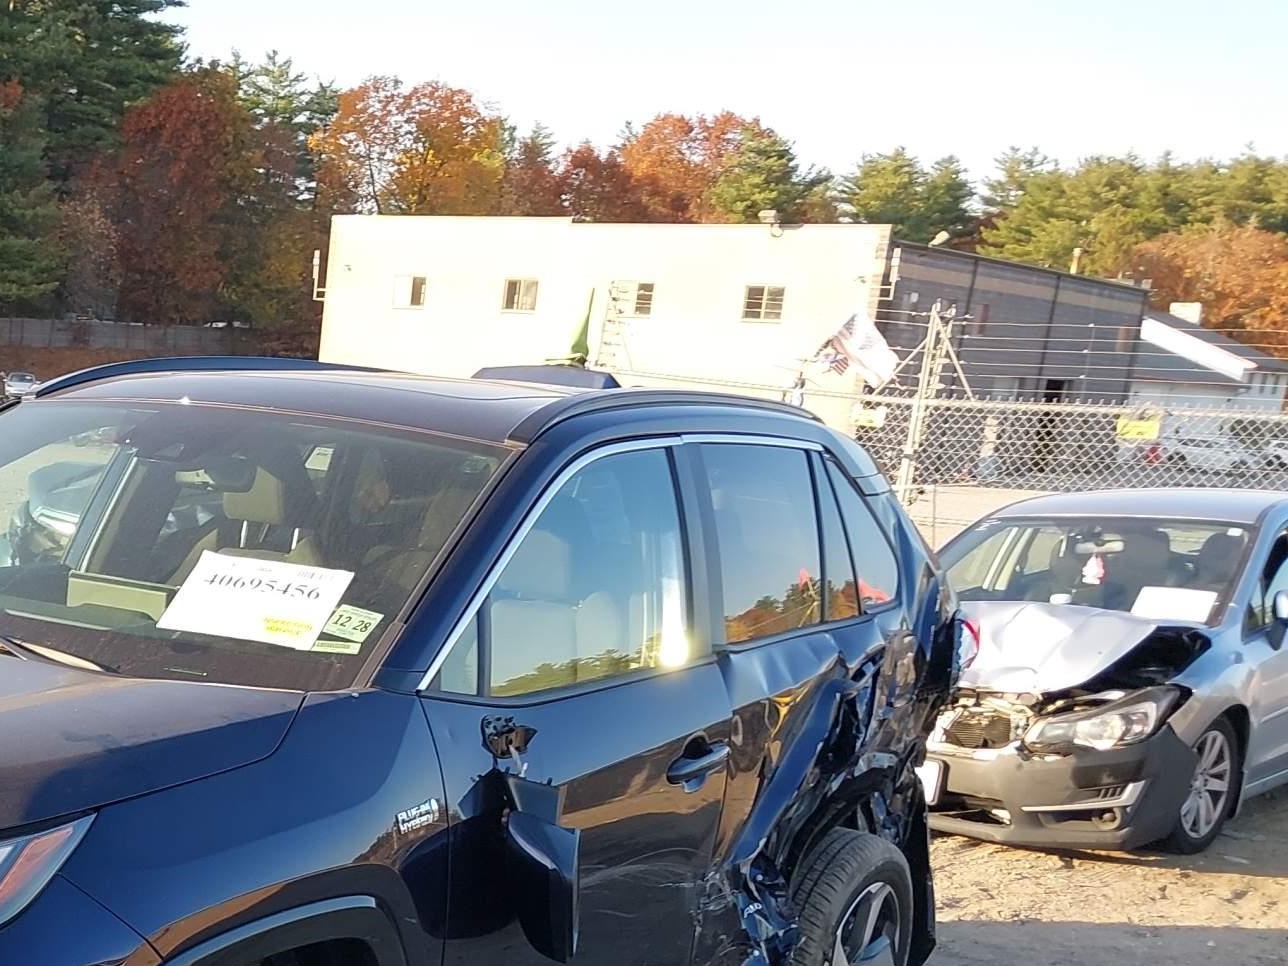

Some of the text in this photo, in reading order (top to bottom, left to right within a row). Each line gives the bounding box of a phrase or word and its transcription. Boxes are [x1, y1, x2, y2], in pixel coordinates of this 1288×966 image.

[203, 573, 321, 601] 40695456
[332, 614, 352, 628] 12
[351, 620, 372, 633] 28
